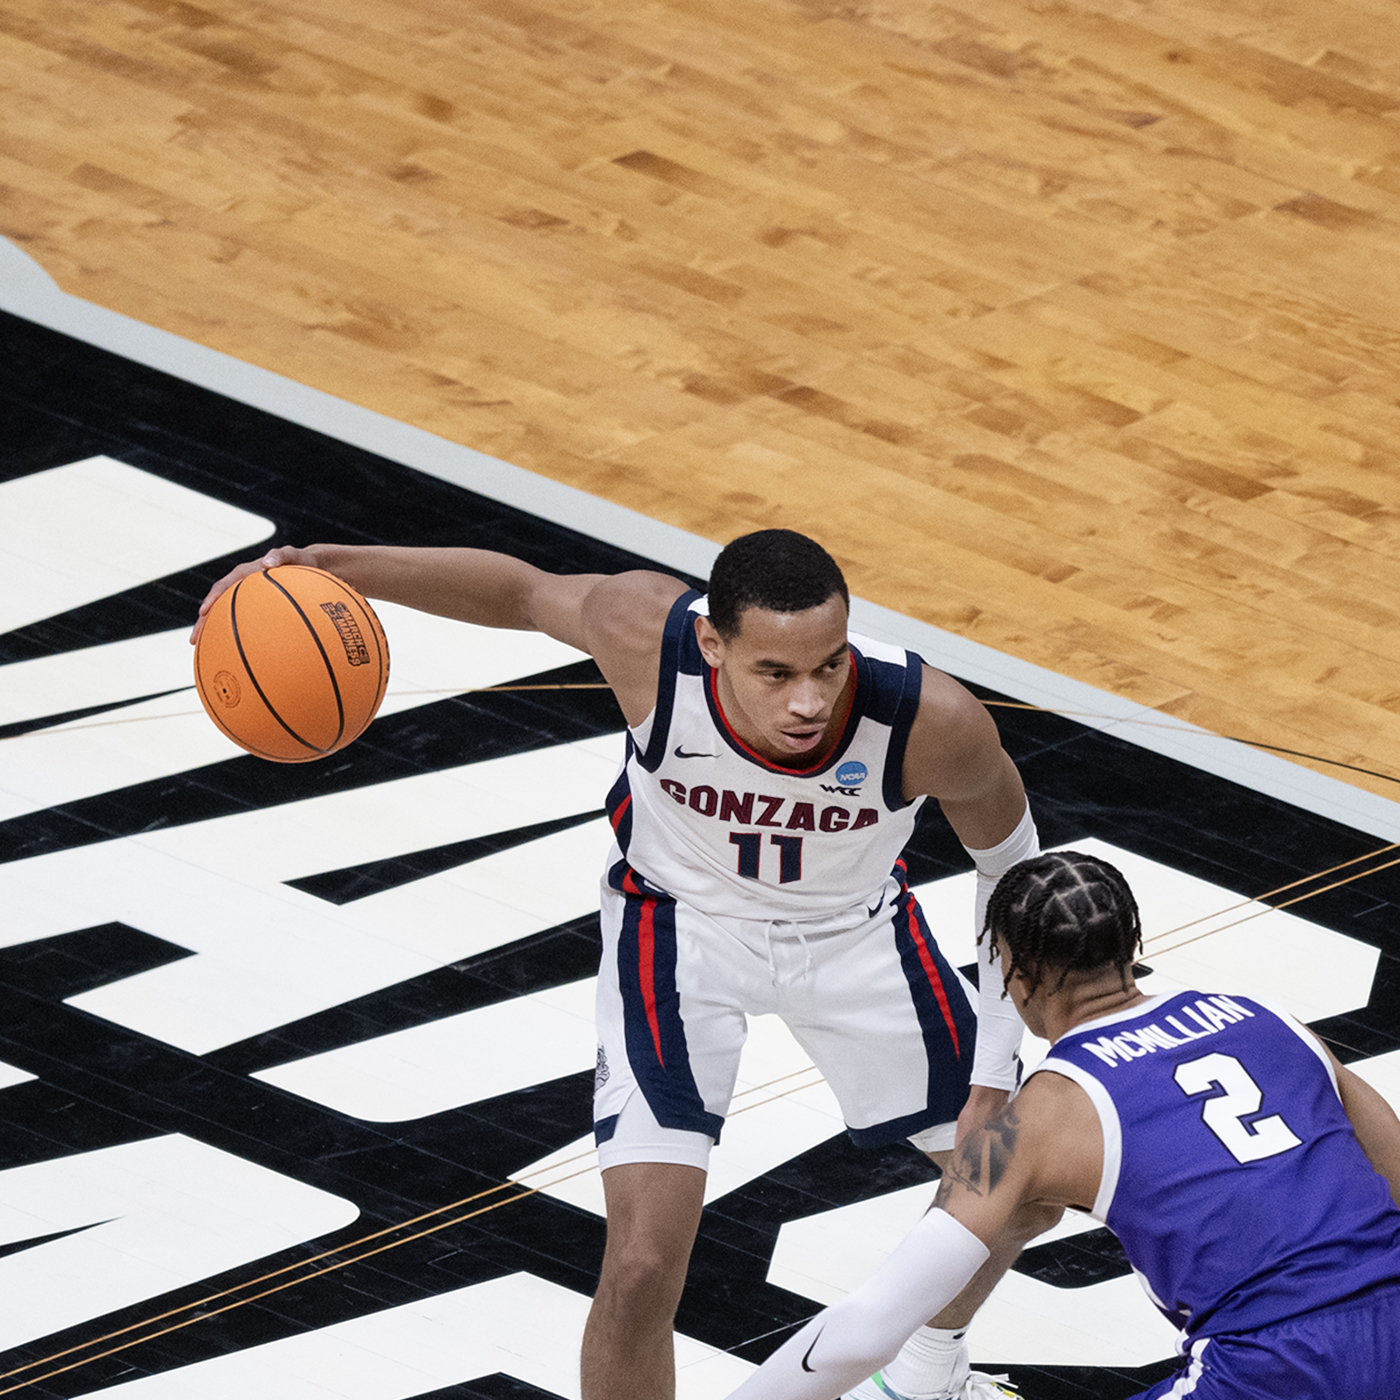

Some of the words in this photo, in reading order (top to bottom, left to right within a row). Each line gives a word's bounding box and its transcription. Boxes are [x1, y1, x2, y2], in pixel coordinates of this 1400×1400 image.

[335, 617, 361, 667] MADNESS
[840, 772, 866, 781] NCAA
[660, 779, 879, 833] GONZAGA
[729, 832, 803, 884] 11
[1172, 1052, 1303, 1165] 2
